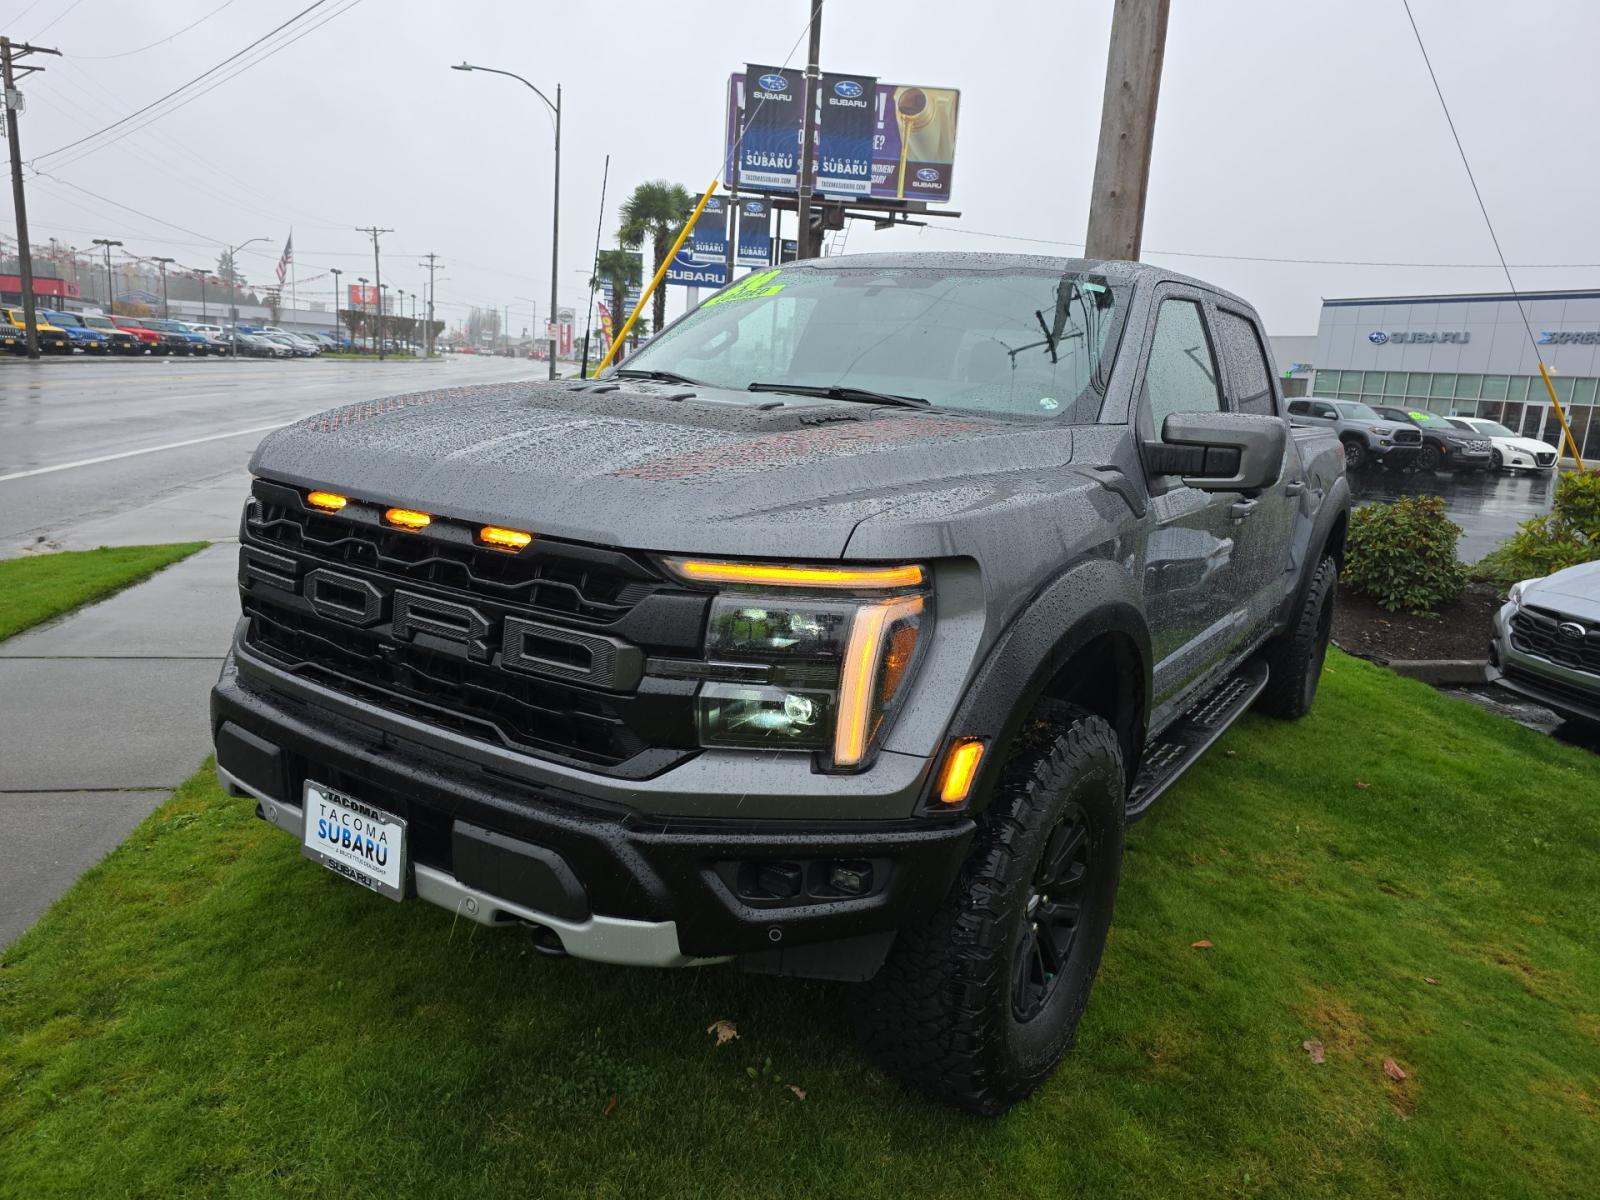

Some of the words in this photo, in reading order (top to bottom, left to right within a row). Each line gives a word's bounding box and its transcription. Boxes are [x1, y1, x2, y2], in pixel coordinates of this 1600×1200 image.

[753, 91, 792, 102] SUBARU
[829, 97, 867, 108] SUBARU
[746, 154, 793, 169] SUBARU
[823, 161, 867, 176] SUBARU
[912, 181, 942, 189] SUBARU
[665, 269, 726, 284] SUBARU
[1390, 331, 1471, 344] SUBARU
[241, 544, 646, 691] FORD
[327, 791, 379, 820] TACOMA
[320, 803, 388, 845] TACOMA
[318, 818, 388, 867] SUBARU
[328, 859, 372, 887] SUBARU
